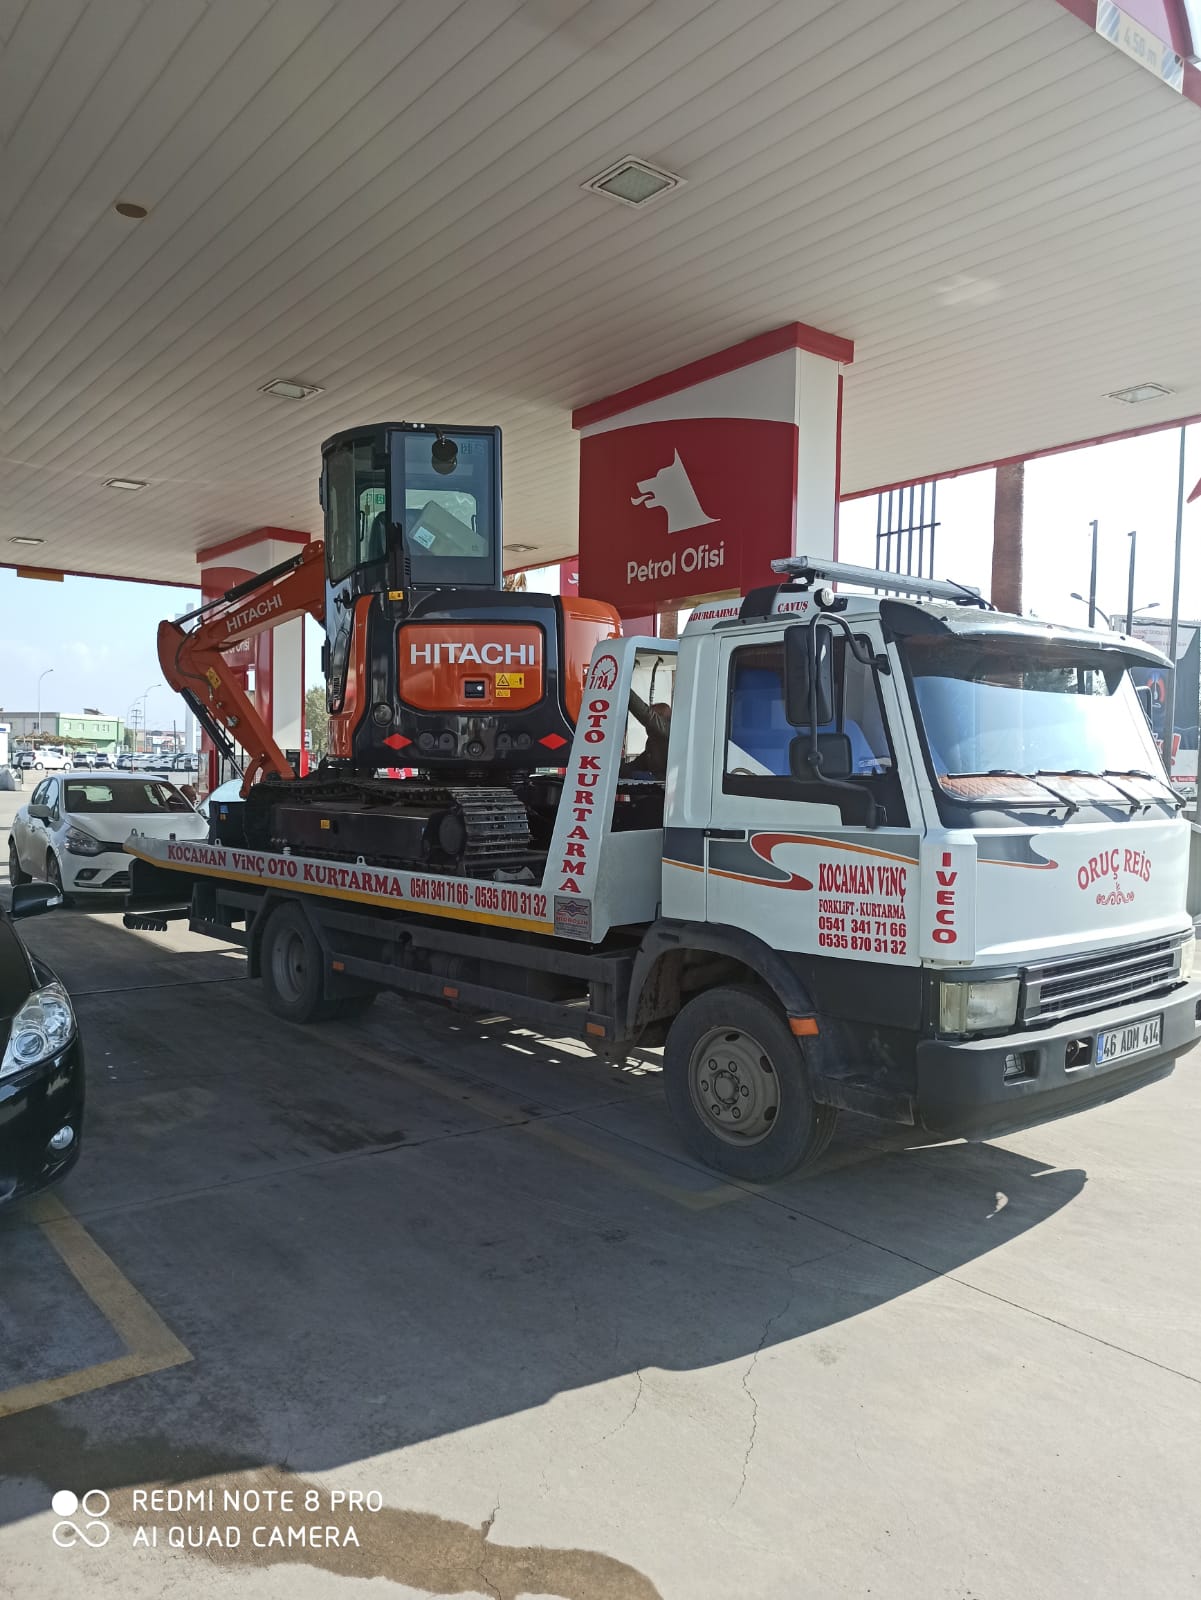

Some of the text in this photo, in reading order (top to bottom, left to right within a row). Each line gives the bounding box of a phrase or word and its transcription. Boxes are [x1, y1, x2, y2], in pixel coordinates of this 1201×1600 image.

[627, 541, 724, 584] Petrol Ofisi
[226, 594, 283, 633] HITACHI
[410, 643, 535, 665] HITACHI
[589, 675, 608, 690] 7/24
[584, 699, 610, 744] OTO
[558, 756, 601, 894] KURTARMA
[167, 845, 227, 867] KOCAMAN
[268, 858, 298, 878] OTO
[303, 864, 403, 897] KURTARMA
[410, 877, 430, 899] 0541
[431, 881, 447, 901] 341
[457, 884, 469, 905] 66
[475, 886, 499, 910] 0535
[501, 890, 518, 914] 870
[521, 892, 532, 916] 31
[533, 894, 547, 918] 32
[818, 863, 875, 895] KOCAMAN
[860, 901, 906, 920] KURTARMA
[932, 852, 958, 944] IVECO
[818, 916, 907, 938] 0541 341 71 66
[818, 932, 907, 955] 0535 870 31 32
[1103, 1034, 1117, 1057] 46
[1120, 1027, 1140, 1053] ADM
